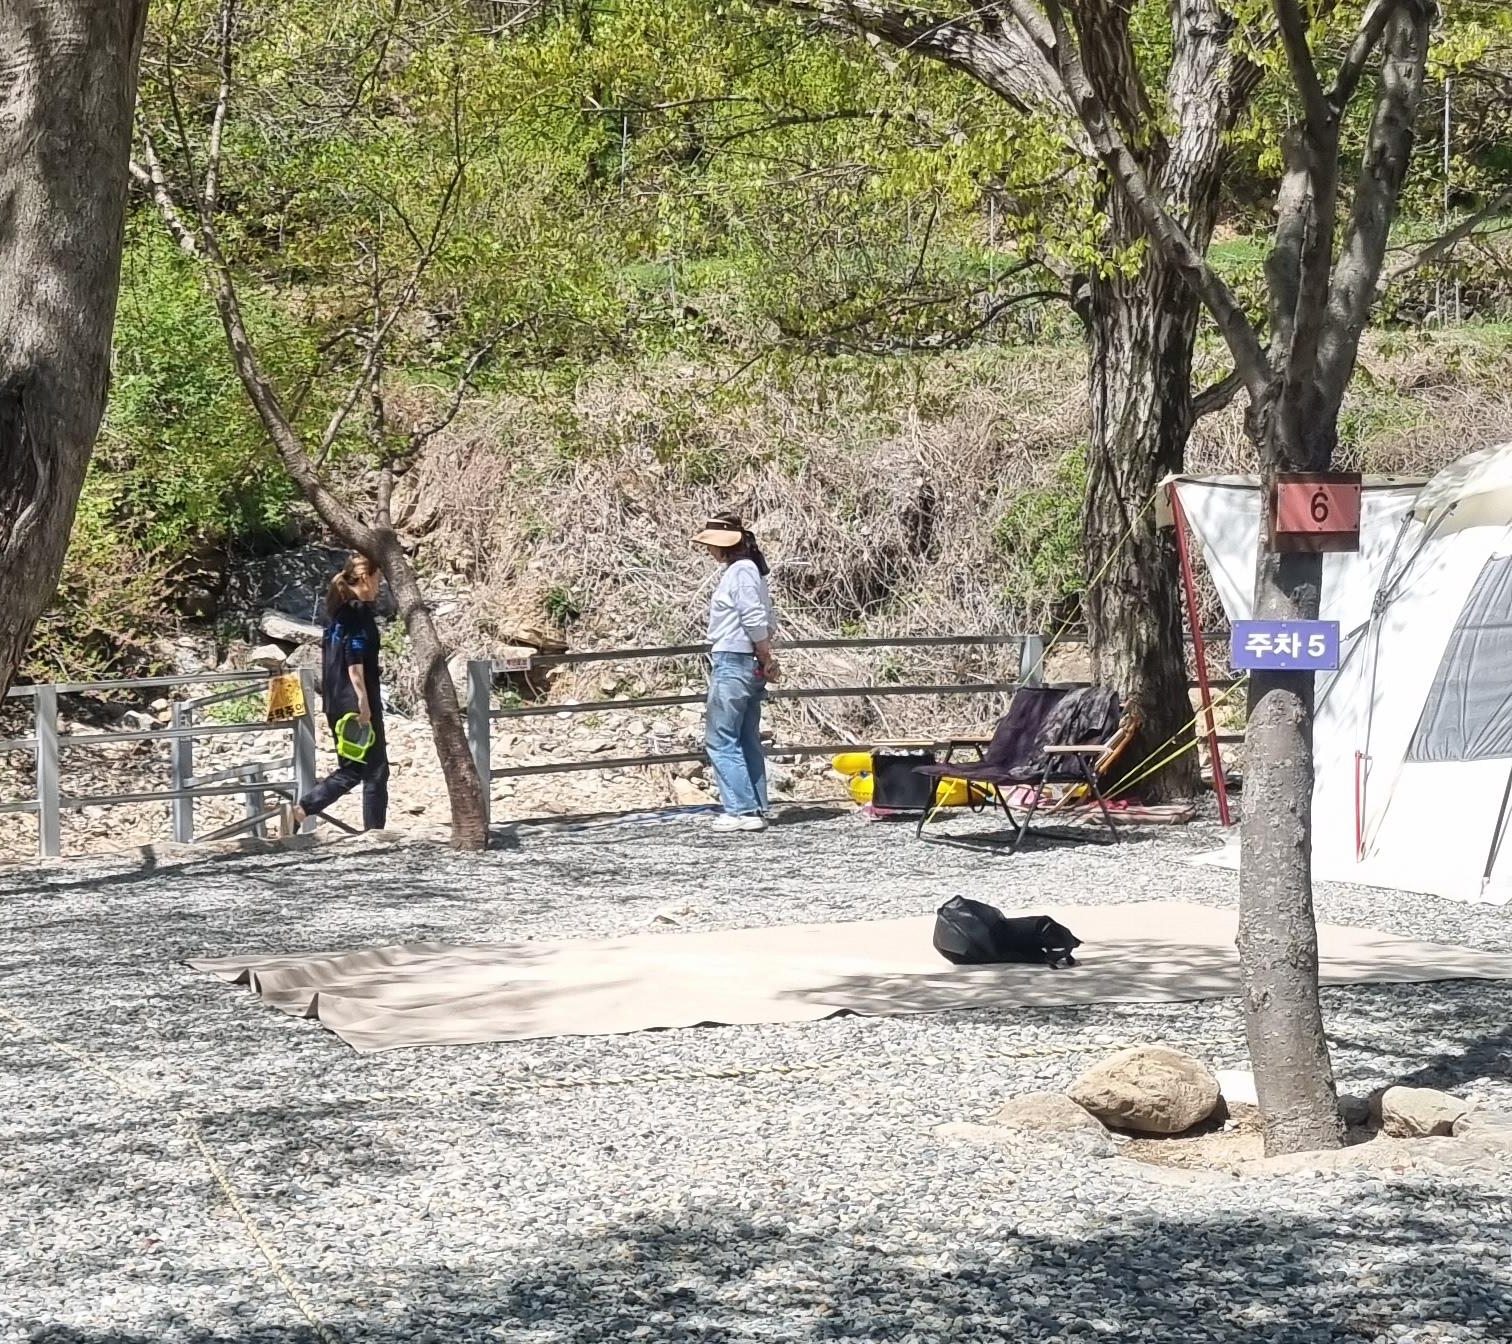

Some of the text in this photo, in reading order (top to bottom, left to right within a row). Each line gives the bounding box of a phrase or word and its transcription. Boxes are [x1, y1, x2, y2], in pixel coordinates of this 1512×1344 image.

[1310, 491, 1329, 523] 6
[1245, 633, 1326, 658] 주차 5
